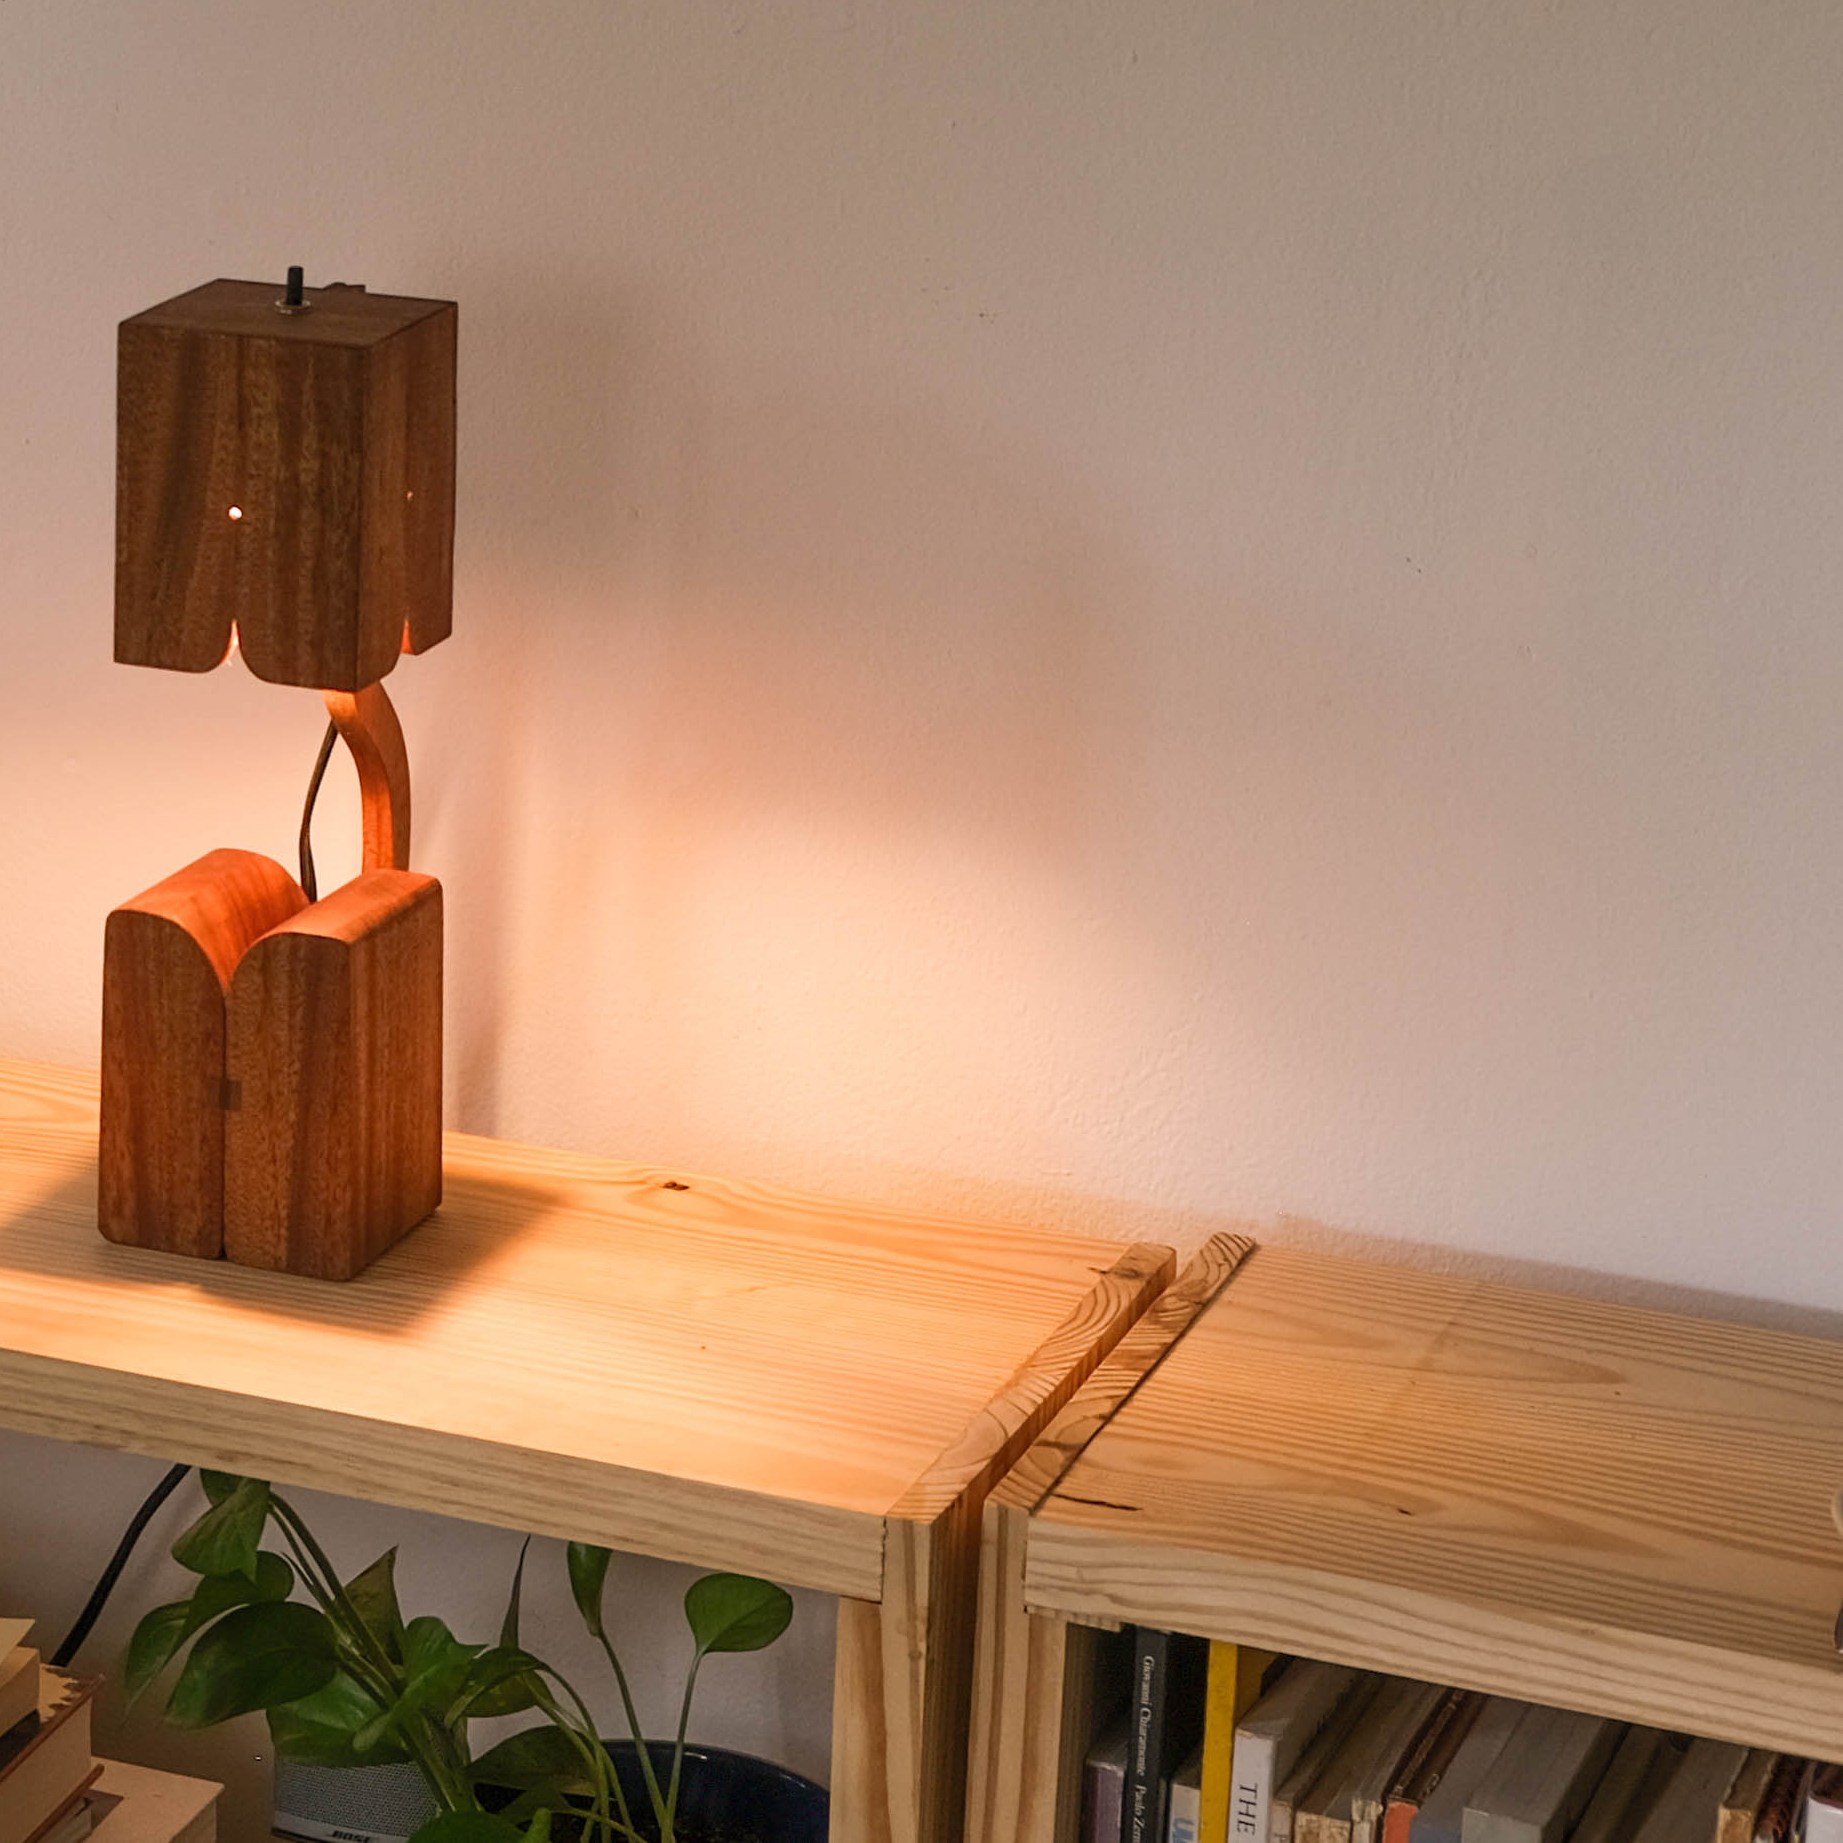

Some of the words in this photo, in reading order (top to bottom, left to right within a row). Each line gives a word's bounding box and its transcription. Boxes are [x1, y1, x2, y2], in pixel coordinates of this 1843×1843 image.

[1141, 1655, 1156, 1706] Giovanni
[1134, 1784, 1148, 1816] Paolo
[1237, 1782, 1259, 1837] THE
